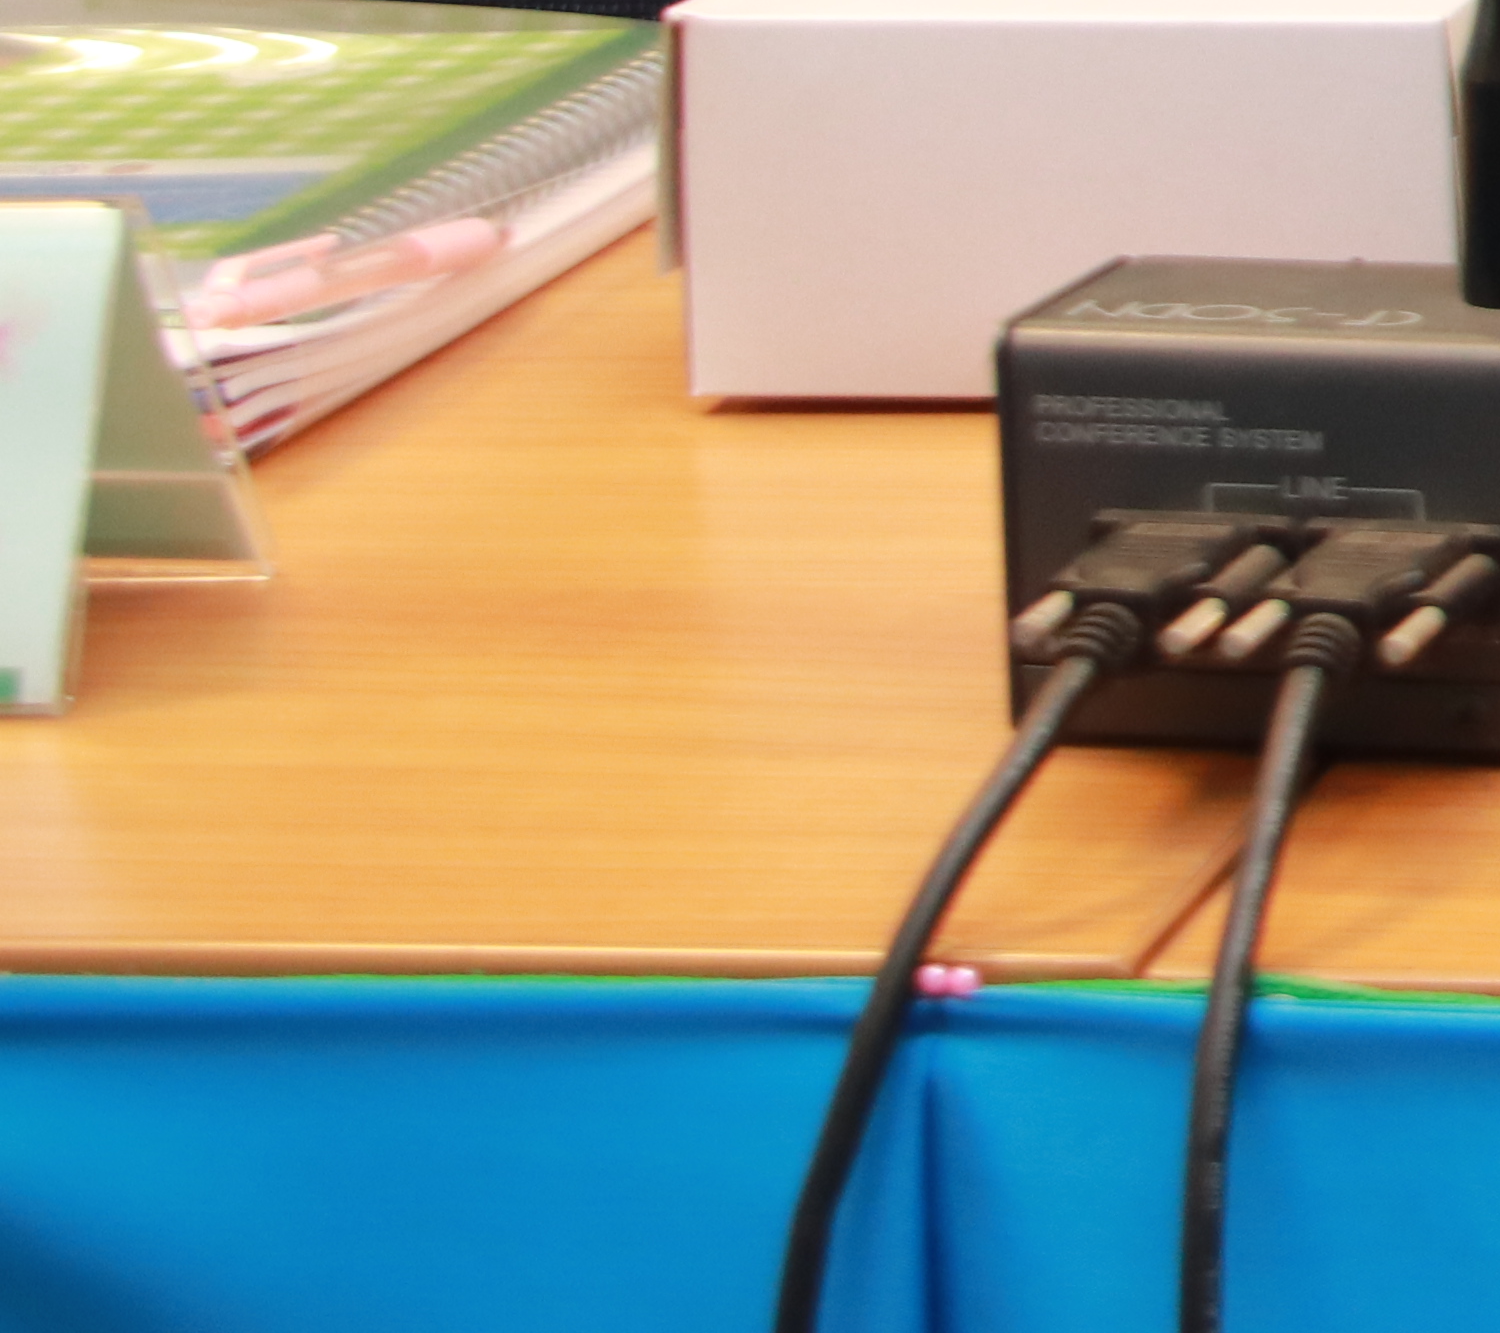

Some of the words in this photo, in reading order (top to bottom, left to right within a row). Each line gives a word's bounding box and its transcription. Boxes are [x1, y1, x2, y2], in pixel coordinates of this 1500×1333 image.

[1033, 394, 1230, 421] PROFESSIONAL
[1034, 421, 1212, 448] CONFERENCE
[1218, 427, 1325, 451] SYSTEM
[1281, 475, 1350, 501] LINE
